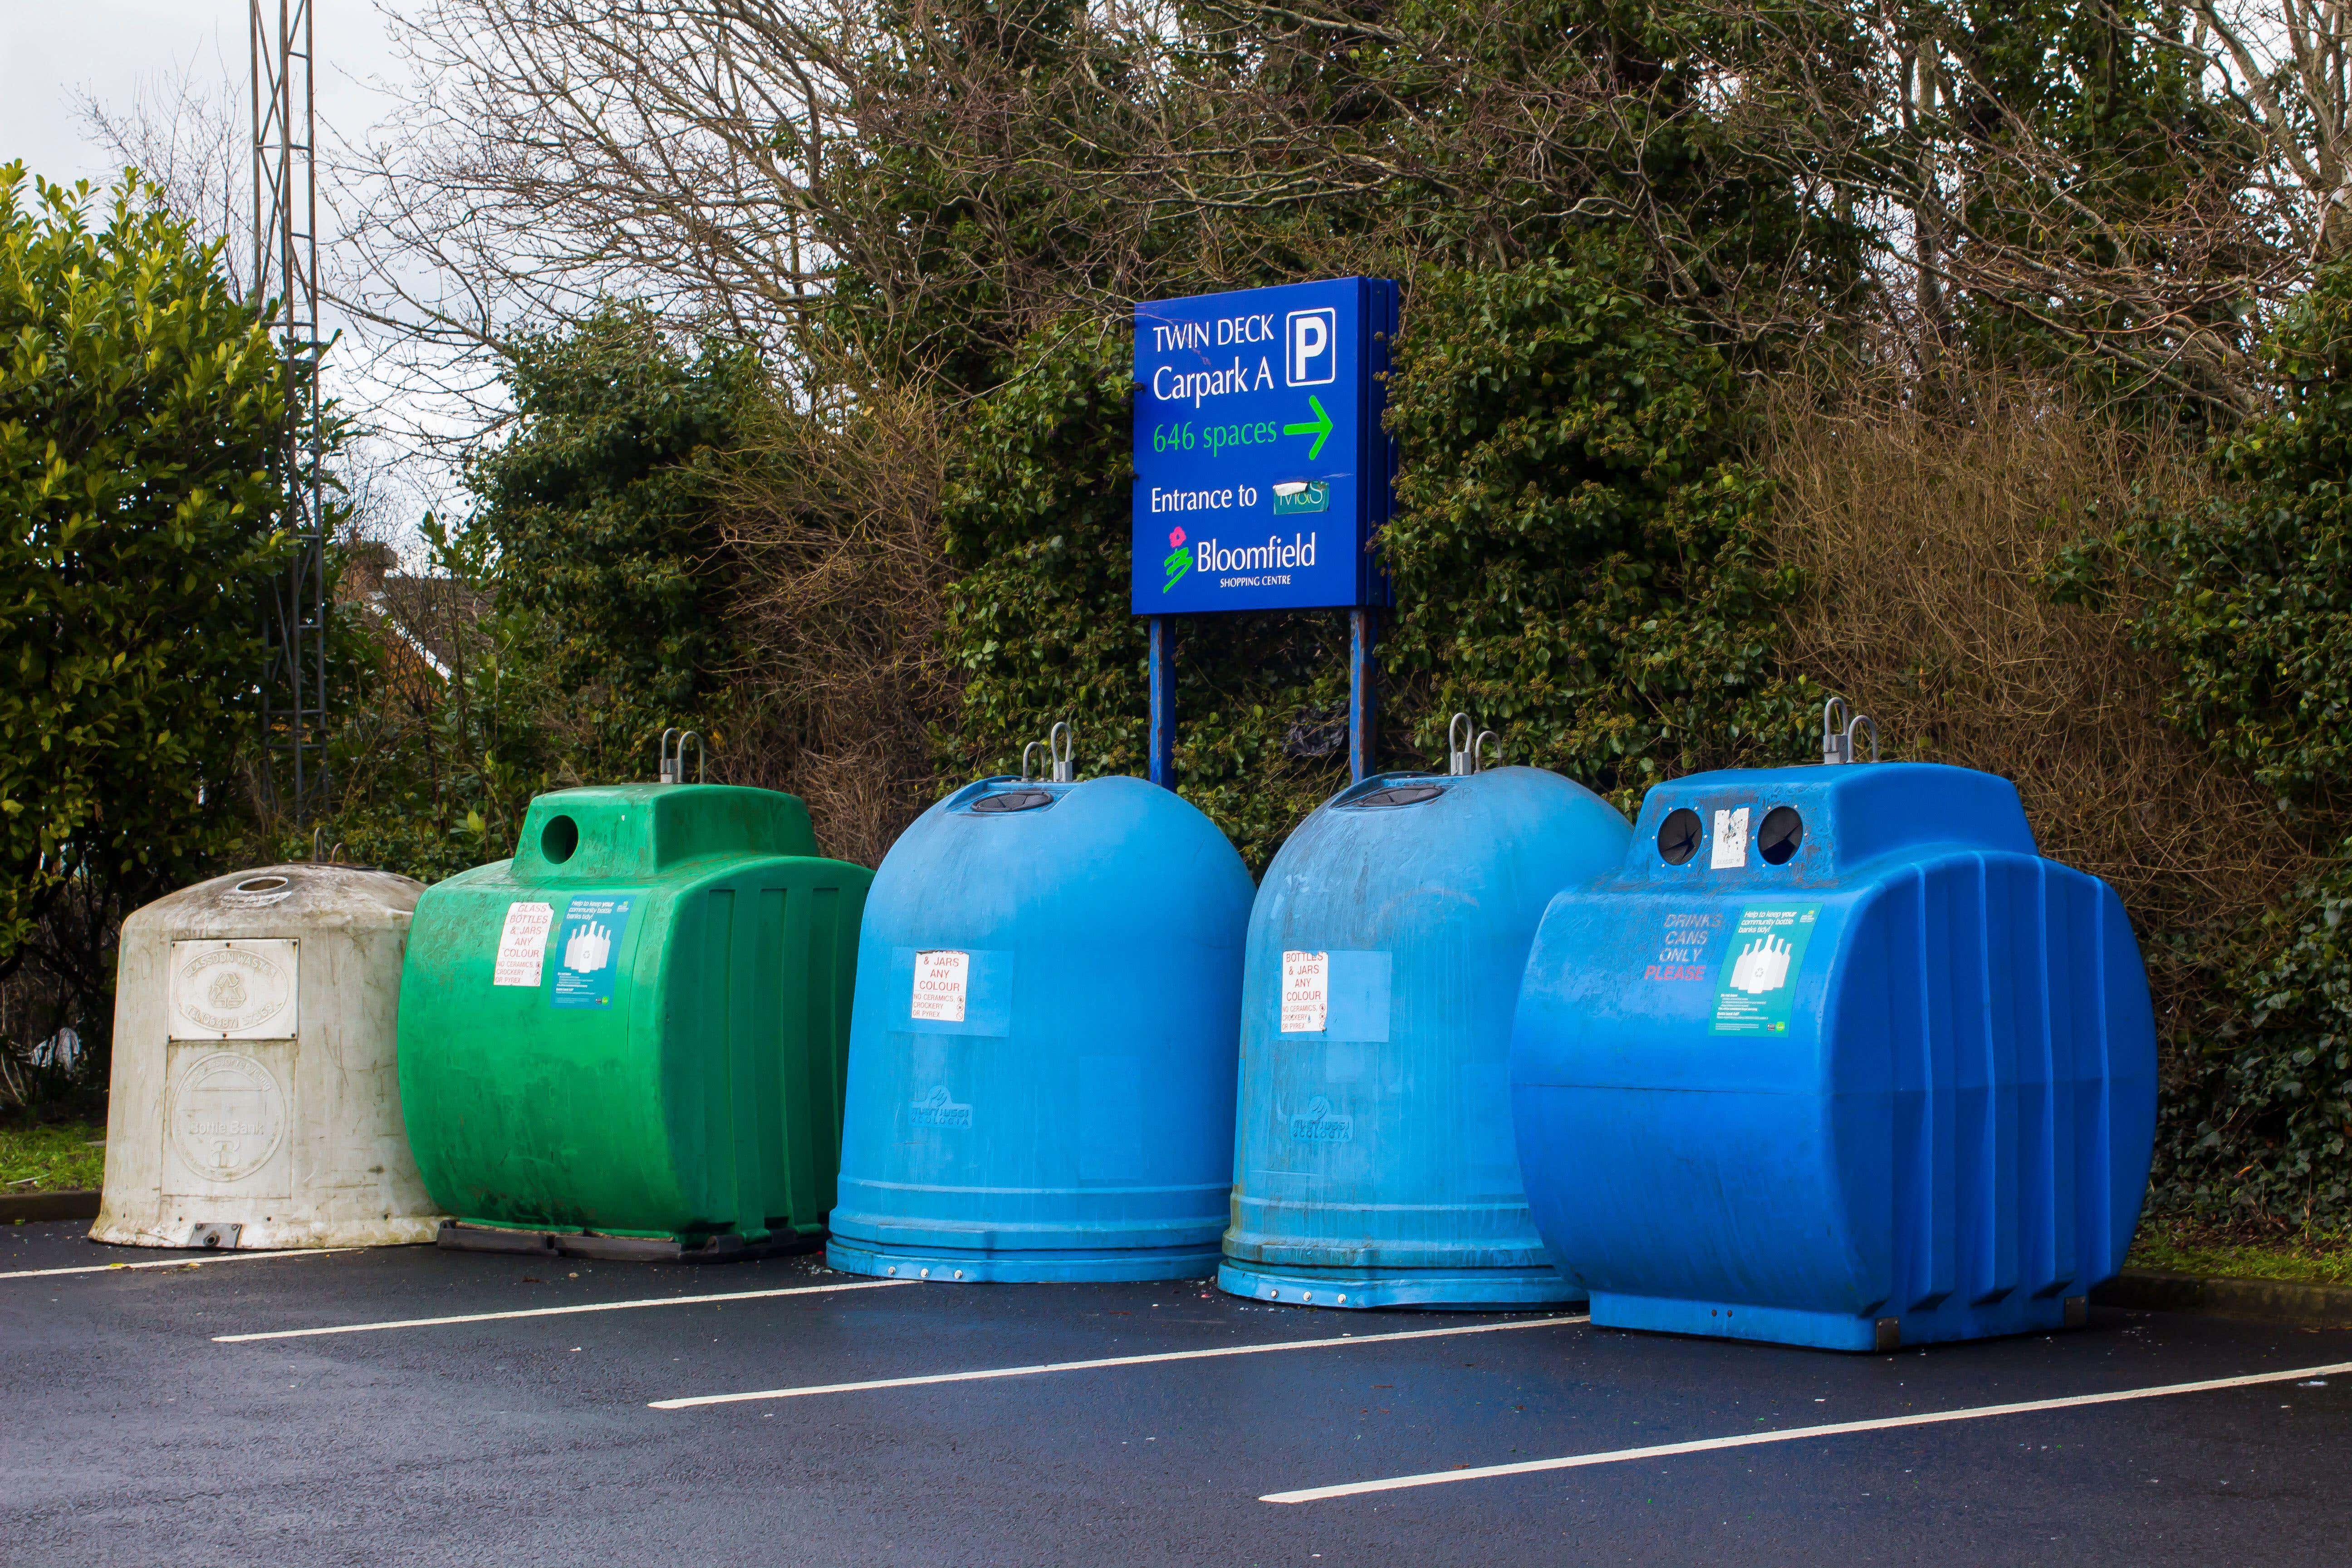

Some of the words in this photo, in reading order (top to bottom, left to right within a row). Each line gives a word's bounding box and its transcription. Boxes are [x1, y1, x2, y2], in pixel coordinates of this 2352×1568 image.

[1153, 322, 1209, 352] TWIN
[1217, 314, 1274, 346] DECK
[1296, 317, 1327, 380] P
[1153, 356, 1248, 408] Carpark
[1254, 356, 1274, 391] A
[1154, 421, 1195, 452] 646
[1203, 421, 1277, 458] spaces
[1152, 487, 1232, 513] Entrance
[1238, 484, 1257, 507] to
[1197, 532, 1315, 572] Bloomfield
[1220, 577, 1260, 588] SHOPPING
[1262, 575, 1291, 586] CENTRE
[510, 915, 548, 923] BOTTLES
[1664, 913, 1723, 928] DRINKS
[520, 926, 541, 935] JARS
[1665, 931, 1708, 945] CANS
[504, 949, 539, 957] COLOUR
[1286, 952, 1323, 962] BOTTLES
[1659, 947, 1703, 962] ONLY
[185, 953, 234, 978] GLASSDON
[237, 953, 277, 978] WASTES
[924, 956, 929, 965] &
[934, 957, 959, 967] JARS
[930, 969, 950, 978] ANY
[1289, 966, 1294, 975] &
[1298, 965, 1319, 975] JARS
[1644, 965, 1705, 980] PLEASE
[920, 980, 960, 991] COLOUR
[1294, 978, 1311, 988] ANY
[1287, 991, 1321, 1001] COLOUR
[189, 1122, 226, 1135] Bottle
[230, 1121, 265, 1135] Bank
